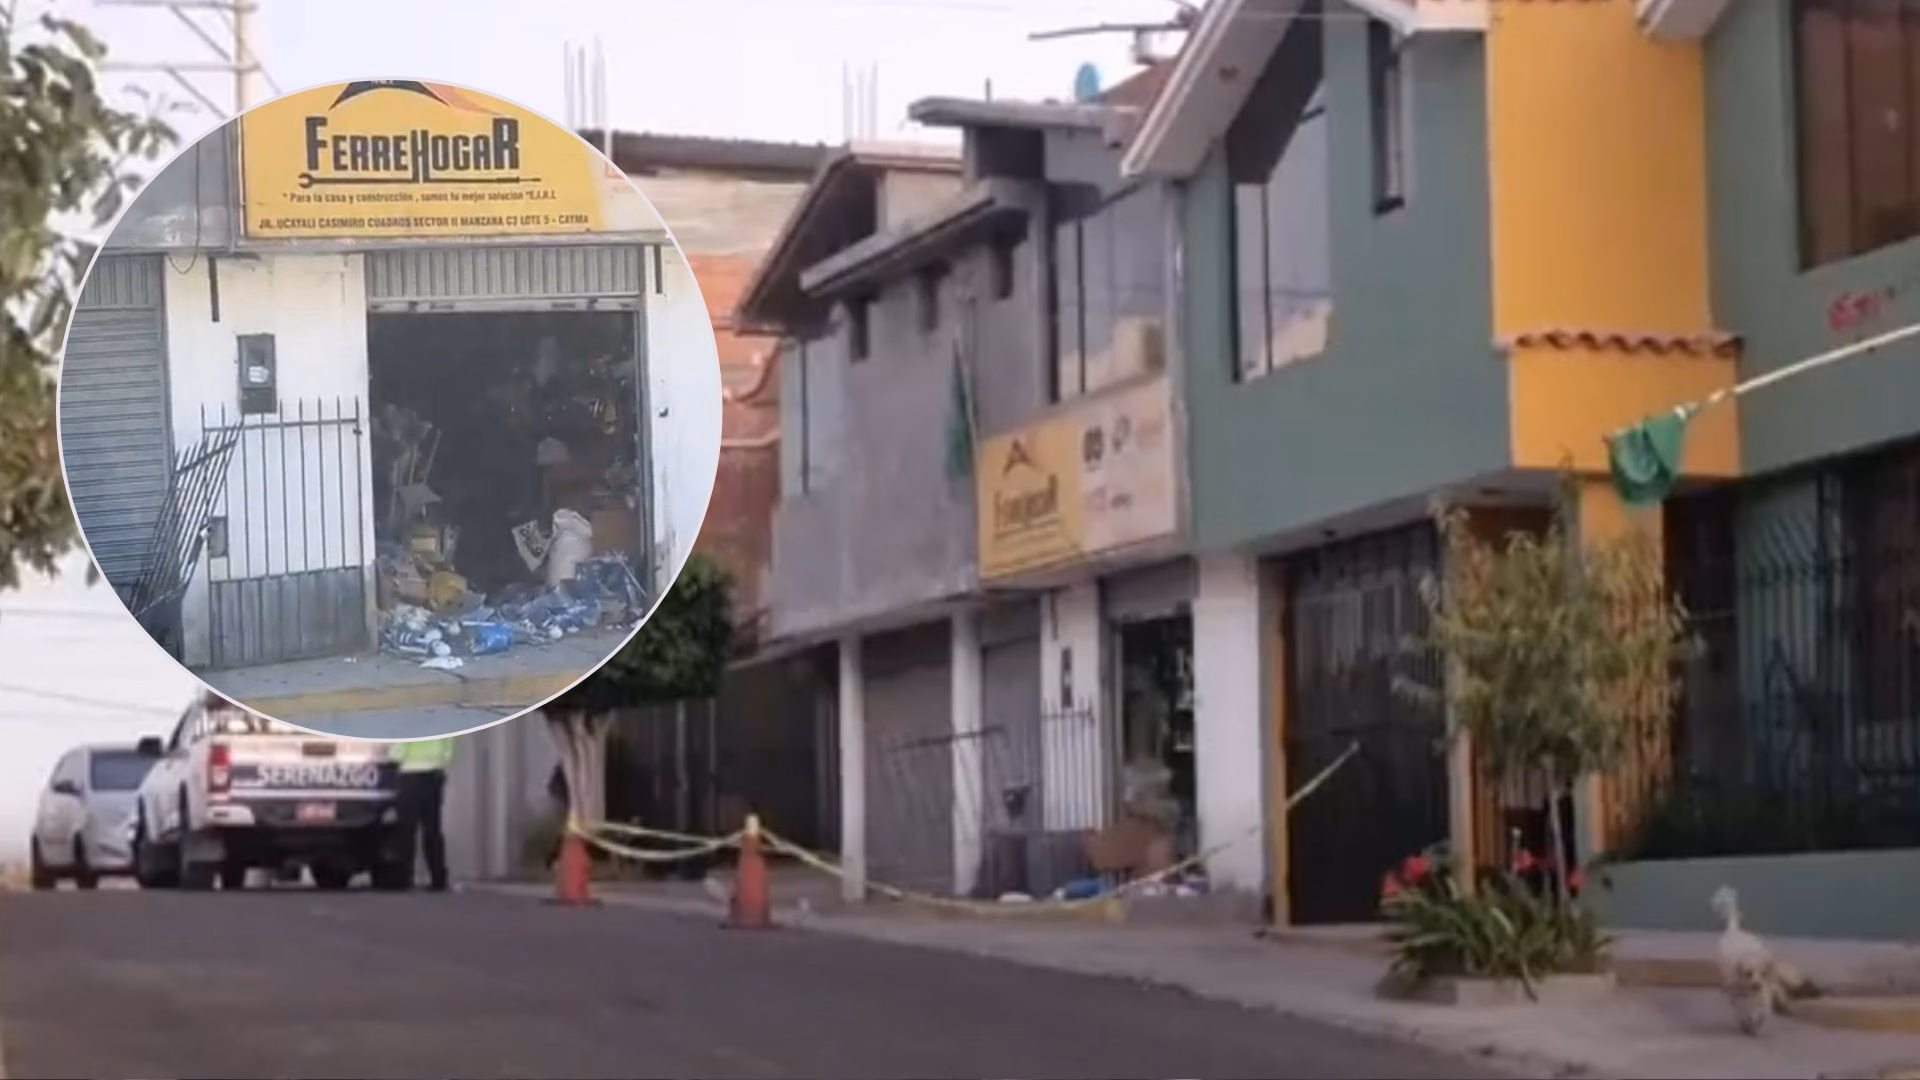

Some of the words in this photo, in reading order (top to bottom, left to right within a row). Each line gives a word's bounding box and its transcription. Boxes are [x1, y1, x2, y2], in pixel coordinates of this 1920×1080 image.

[305, 116, 520, 183] FERREHOGAR
[290, 193, 311, 203] Para
[314, 193, 322, 203] la
[325, 194, 346, 203] casa
[349, 194, 354, 205] y
[421, 193, 448, 202] somos
[462, 191, 486, 203] mejor
[318, 217, 364, 228] CASIMIRO
[368, 217, 411, 228] CUADROS
[414, 217, 449, 227] SECTOR
[461, 216, 504, 226] MANZANA
[520, 215, 541, 225] LOTE
[558, 215, 589, 225] CAYMA
[257, 763, 379, 787] SERENAZGO
